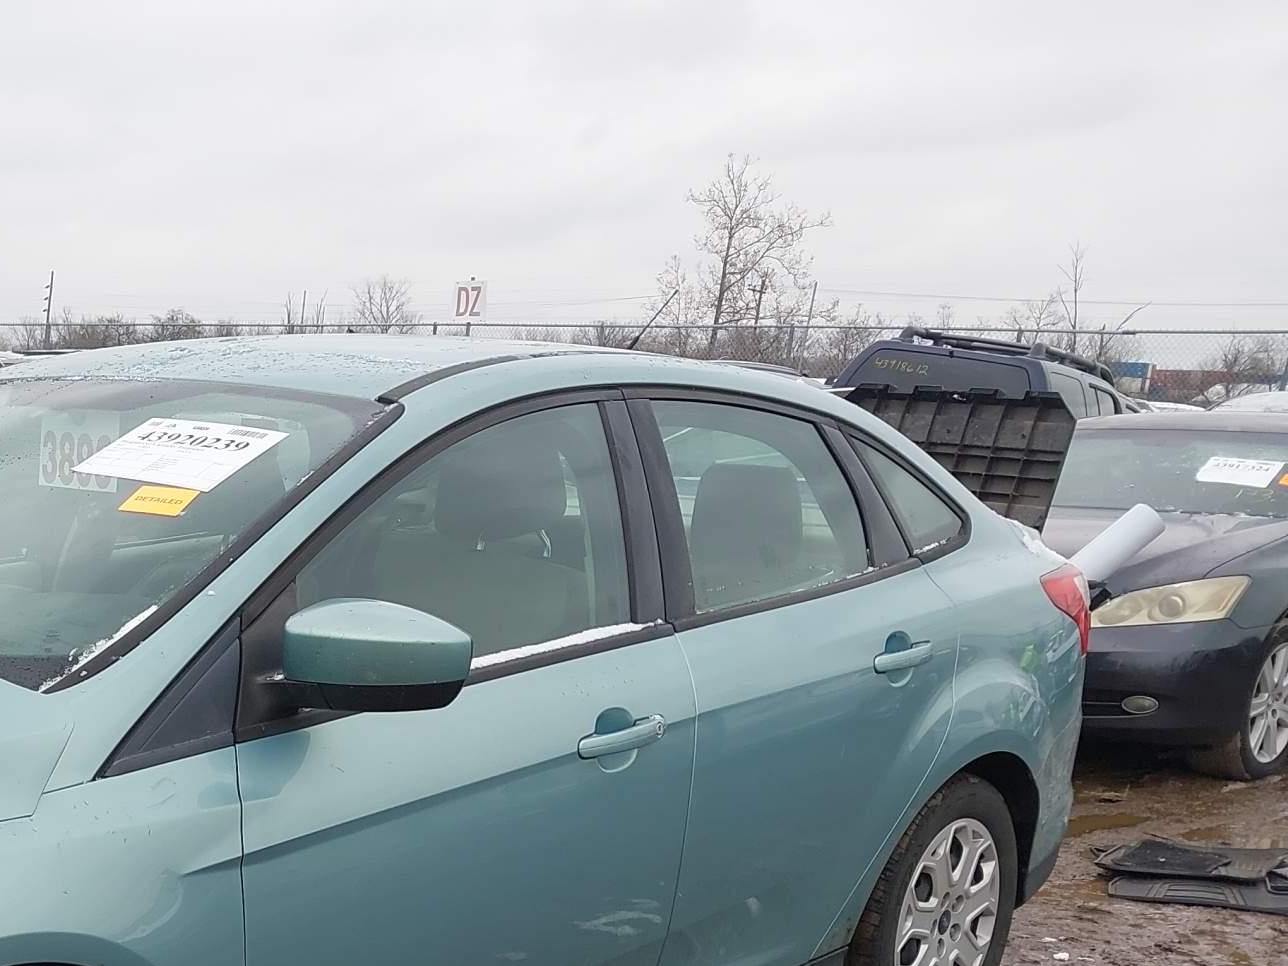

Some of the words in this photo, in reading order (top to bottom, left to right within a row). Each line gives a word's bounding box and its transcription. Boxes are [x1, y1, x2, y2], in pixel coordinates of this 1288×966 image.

[455, 286, 482, 317] DZ
[137, 429, 251, 452] 43920239
[134, 494, 184, 505] DETAILED
